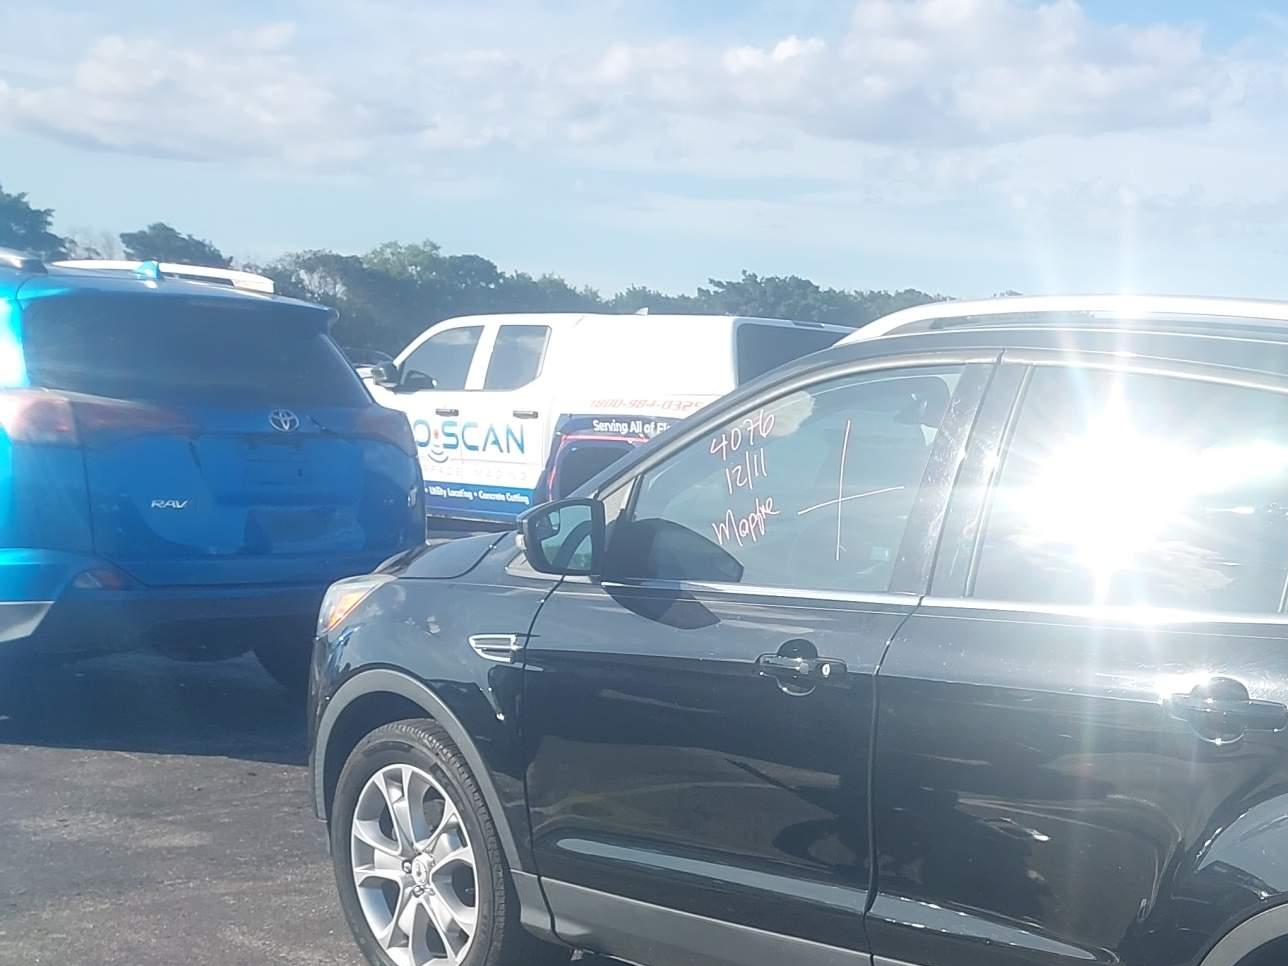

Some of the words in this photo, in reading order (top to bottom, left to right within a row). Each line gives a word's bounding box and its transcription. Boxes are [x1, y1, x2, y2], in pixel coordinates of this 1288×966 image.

[441, 420, 525, 454] SCAN
[592, 419, 628, 435] Serving
[629, 420, 642, 433] All
[643, 421, 656, 433] of
[710, 408, 775, 461] 4076
[726, 447, 767, 495] 12/11
